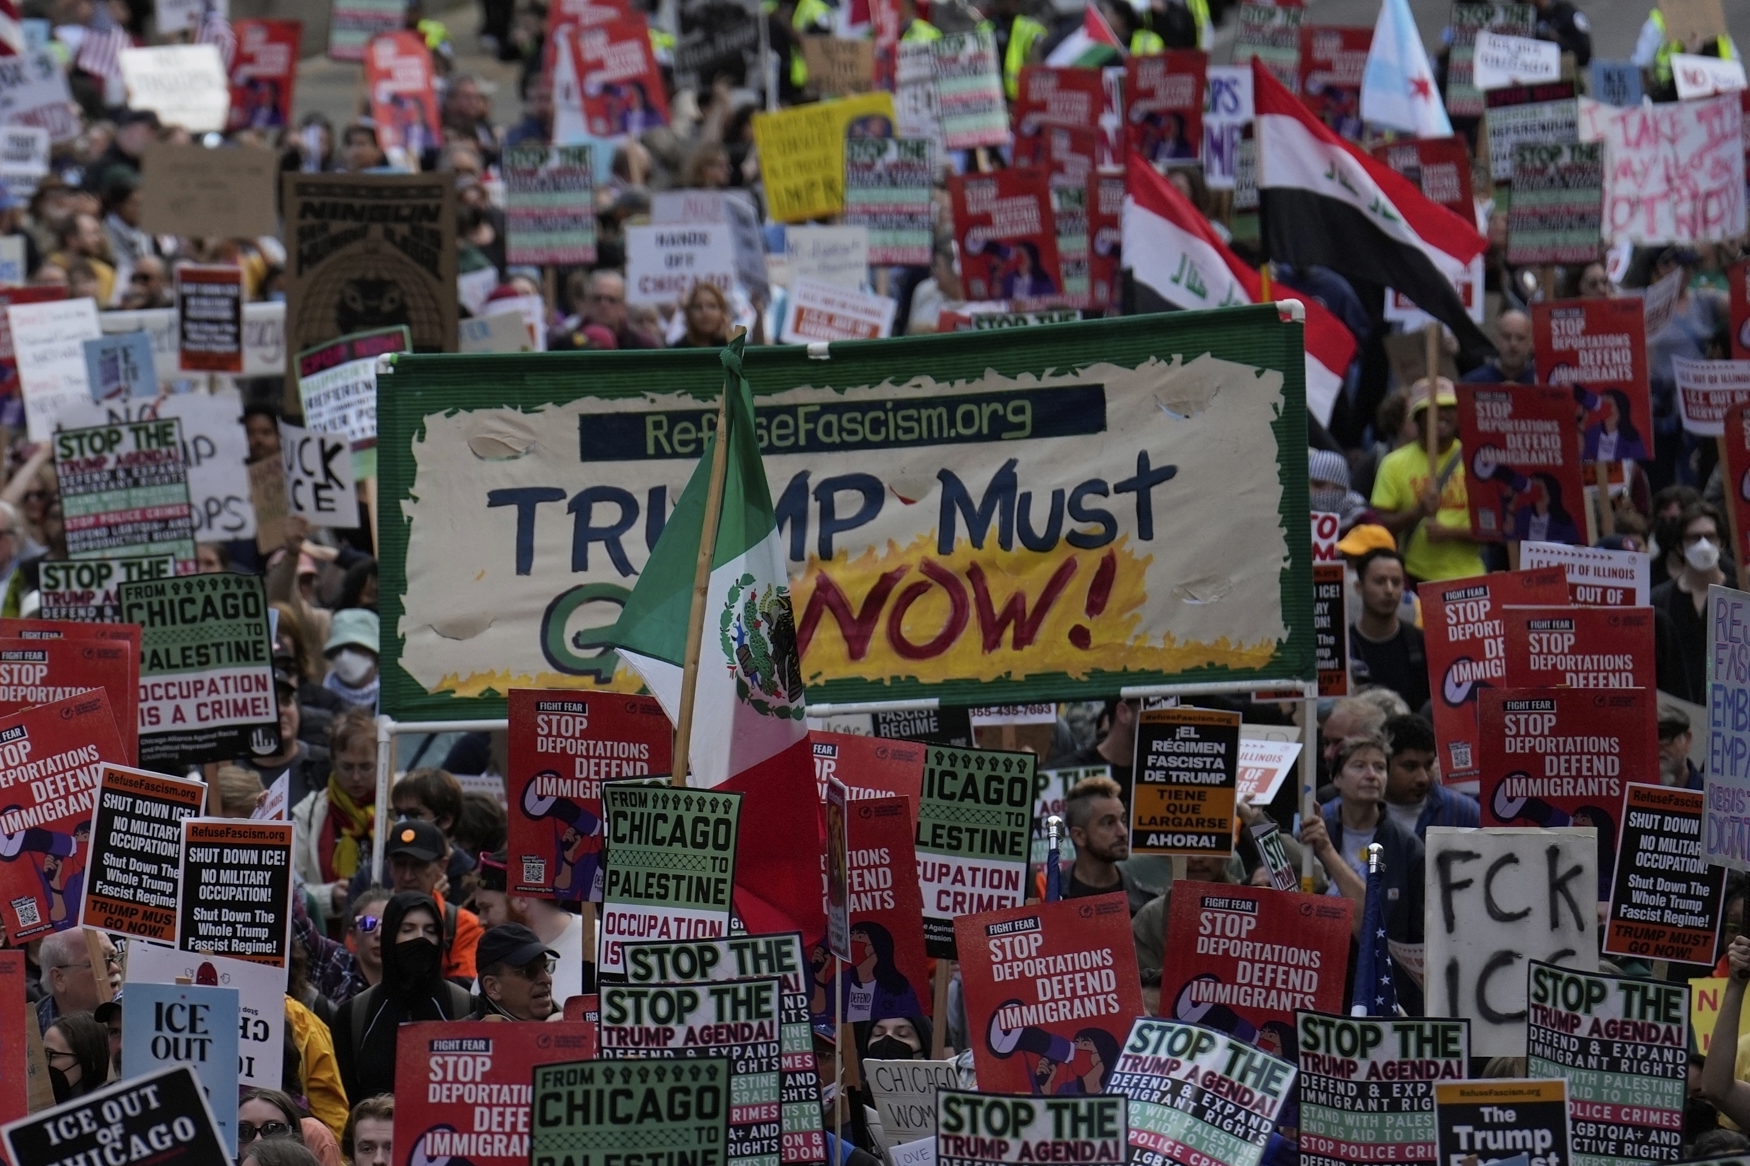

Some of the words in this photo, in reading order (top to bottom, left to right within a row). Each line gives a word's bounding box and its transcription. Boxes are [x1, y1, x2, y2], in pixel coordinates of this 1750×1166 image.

[655, 232, 711, 247] HANDS
[665, 255, 695, 268] OFF
[645, 396, 1034, 456] RefseFascism.org
[936, 449, 1178, 555] Must
[797, 550, 1118, 661] NOW!
[1507, 701, 1529, 711] FIGHT
[1532, 700, 1551, 710] FEAR
[1504, 714, 1557, 736] STOP
[1152, 738, 1226, 754] RÉGIMEN
[1505, 737, 1620, 754] DEPORTATIONS
[1147, 755, 1225, 769] FASCISTA
[1545, 755, 1620, 777] DEFEND
[1144, 770, 1166, 782] DE
[1169, 771, 1227, 785] TRUMP
[1157, 789, 1207, 801] TIENE
[1505, 778, 1621, 797] IMMIGRANTS
[1166, 803, 1201, 814] QUE
[1138, 816, 1228, 829] LARGARSE
[1146, 833, 1216, 848] AHORA!
[1436, 844, 1585, 934] FCK
[540, 1066, 595, 1089] FROM
[43, 1107, 98, 1147] ICE
[101, 1083, 159, 1124] OUT
[537, 1085, 721, 1128] CHICAGO
[95, 1123, 125, 1146] OF
[693, 1126, 719, 1144] TO
